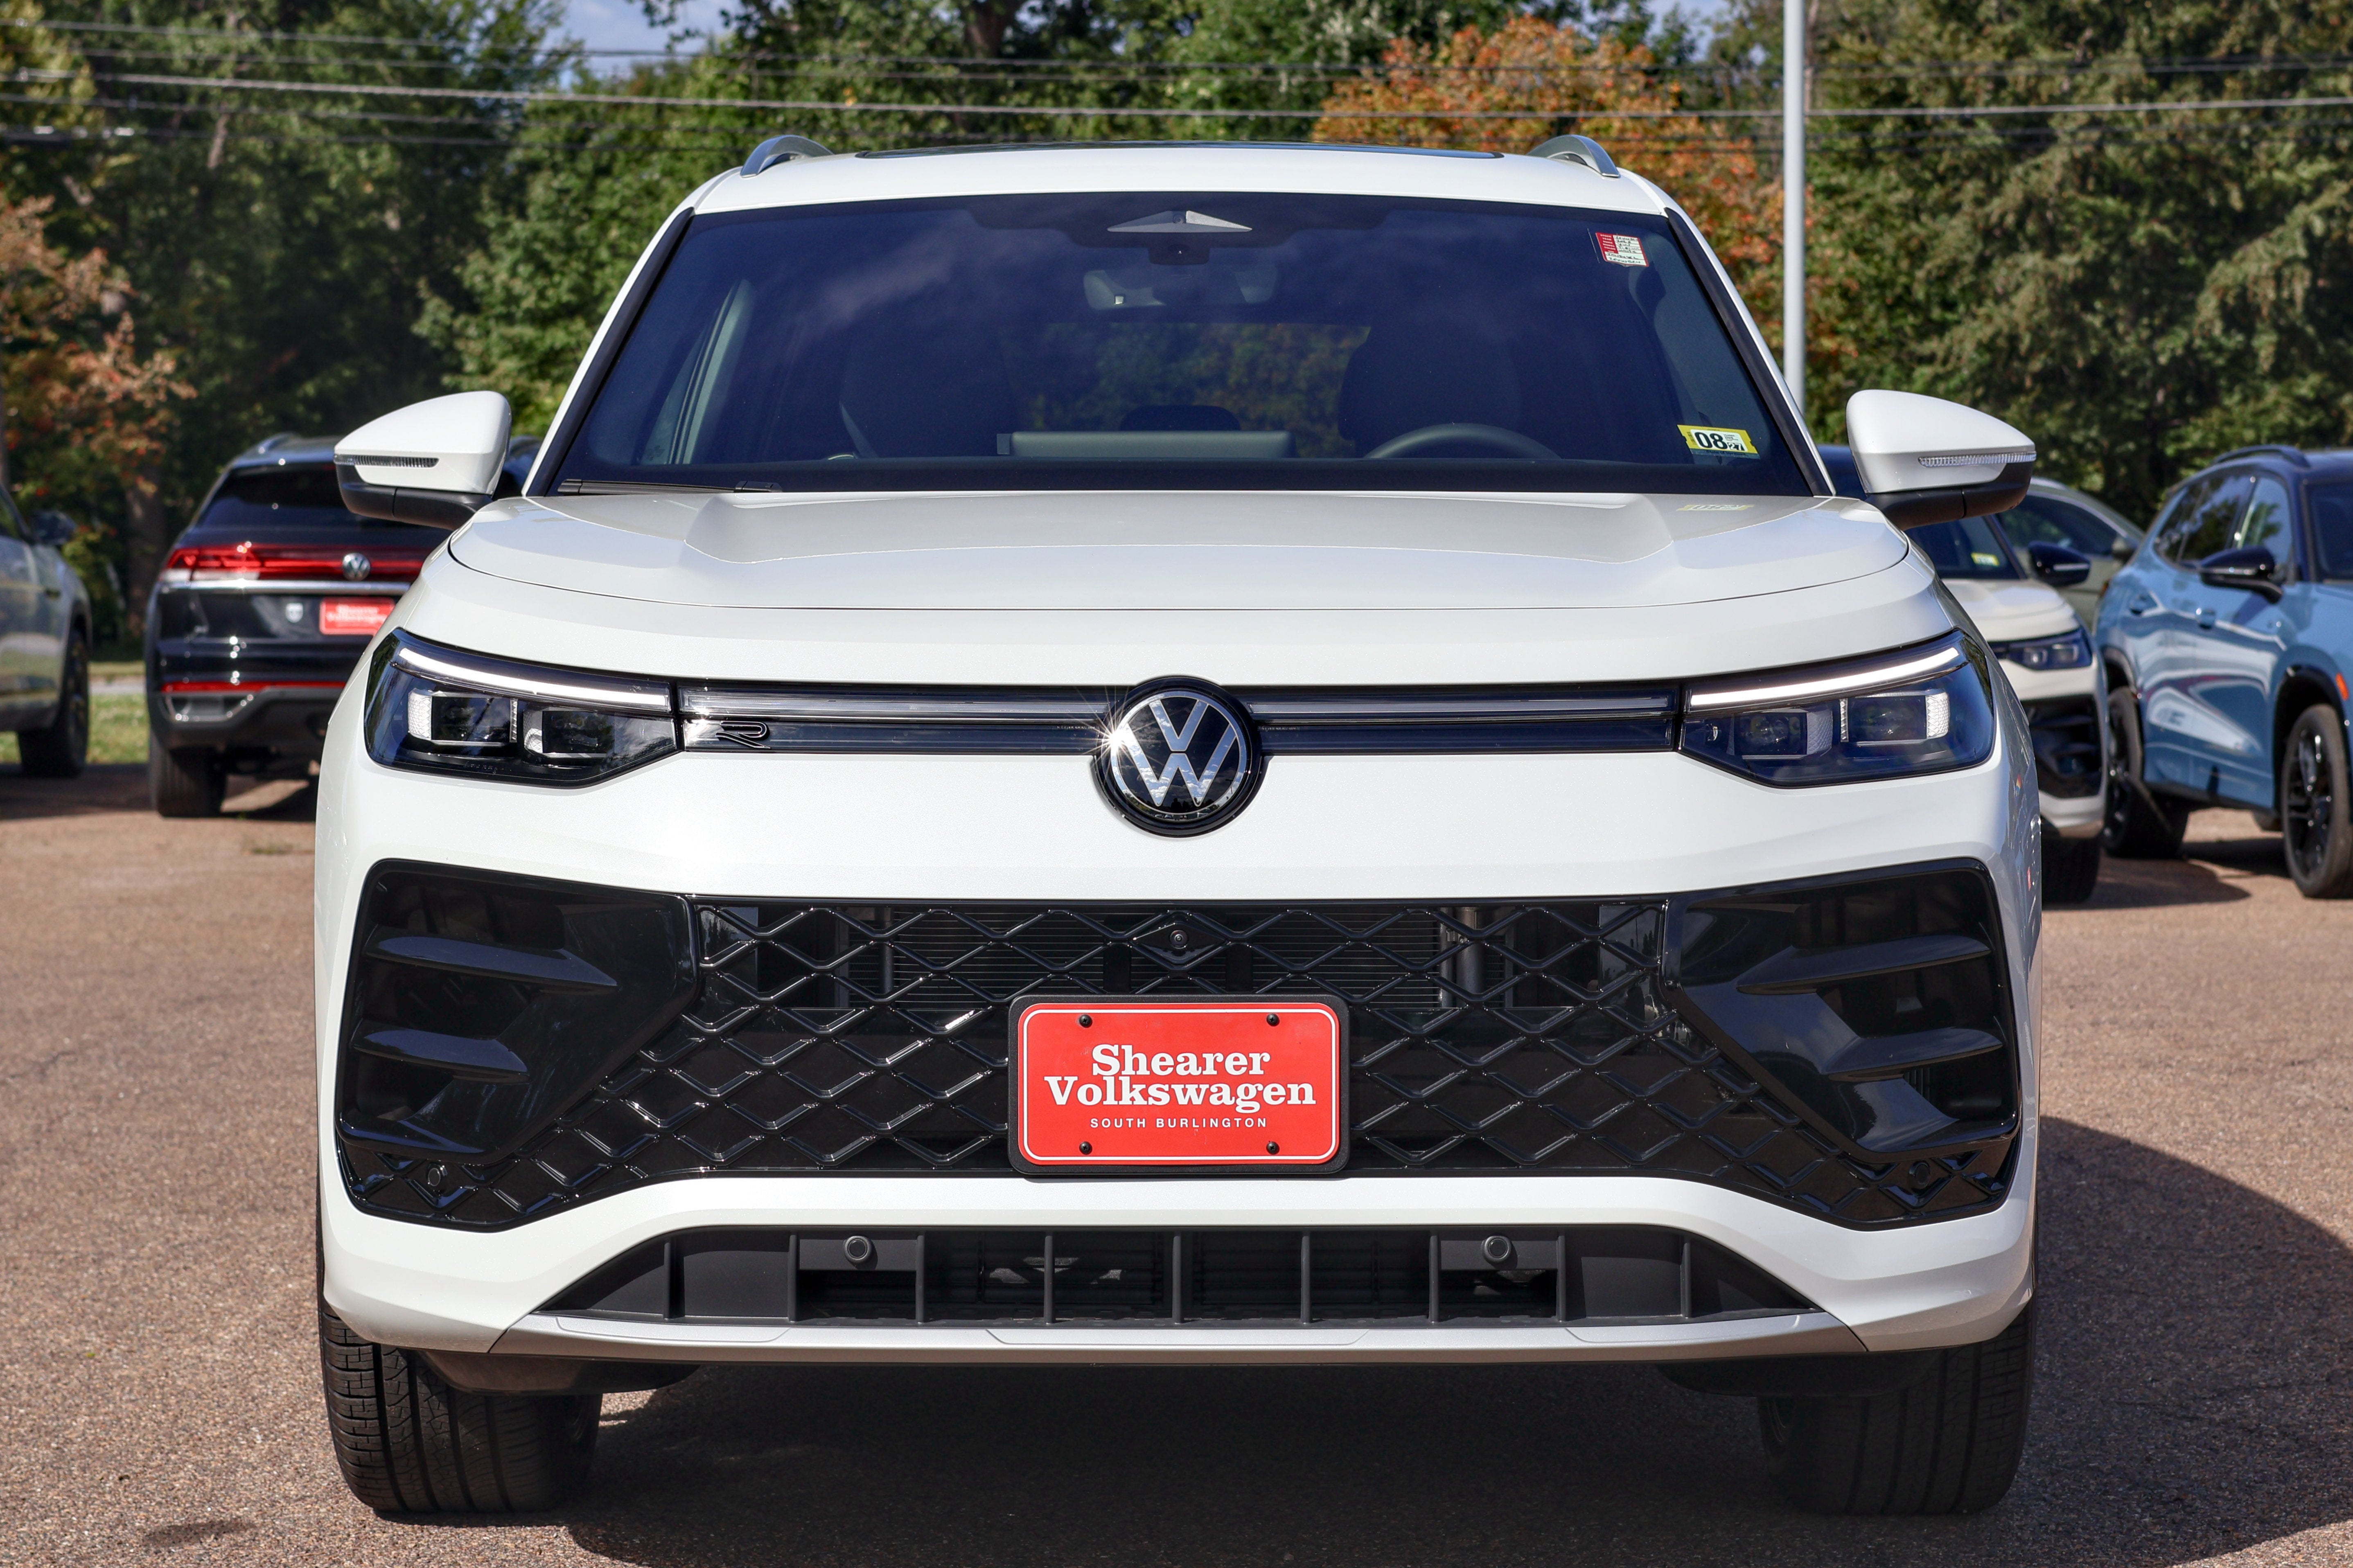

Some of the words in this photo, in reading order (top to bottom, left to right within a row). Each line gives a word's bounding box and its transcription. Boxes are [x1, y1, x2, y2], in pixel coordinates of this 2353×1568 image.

[1694, 432, 1728, 450] 08
[1728, 442, 1743, 451] 27
[716, 721, 772, 749] R
[1117, 695, 1241, 812] VW
[1092, 1044, 1270, 1076] Shearer
[1044, 1076, 1316, 1113] Volkswagen
[1090, 1117, 1146, 1128] SOUTH
[1156, 1117, 1267, 1128] BURLINGTON
